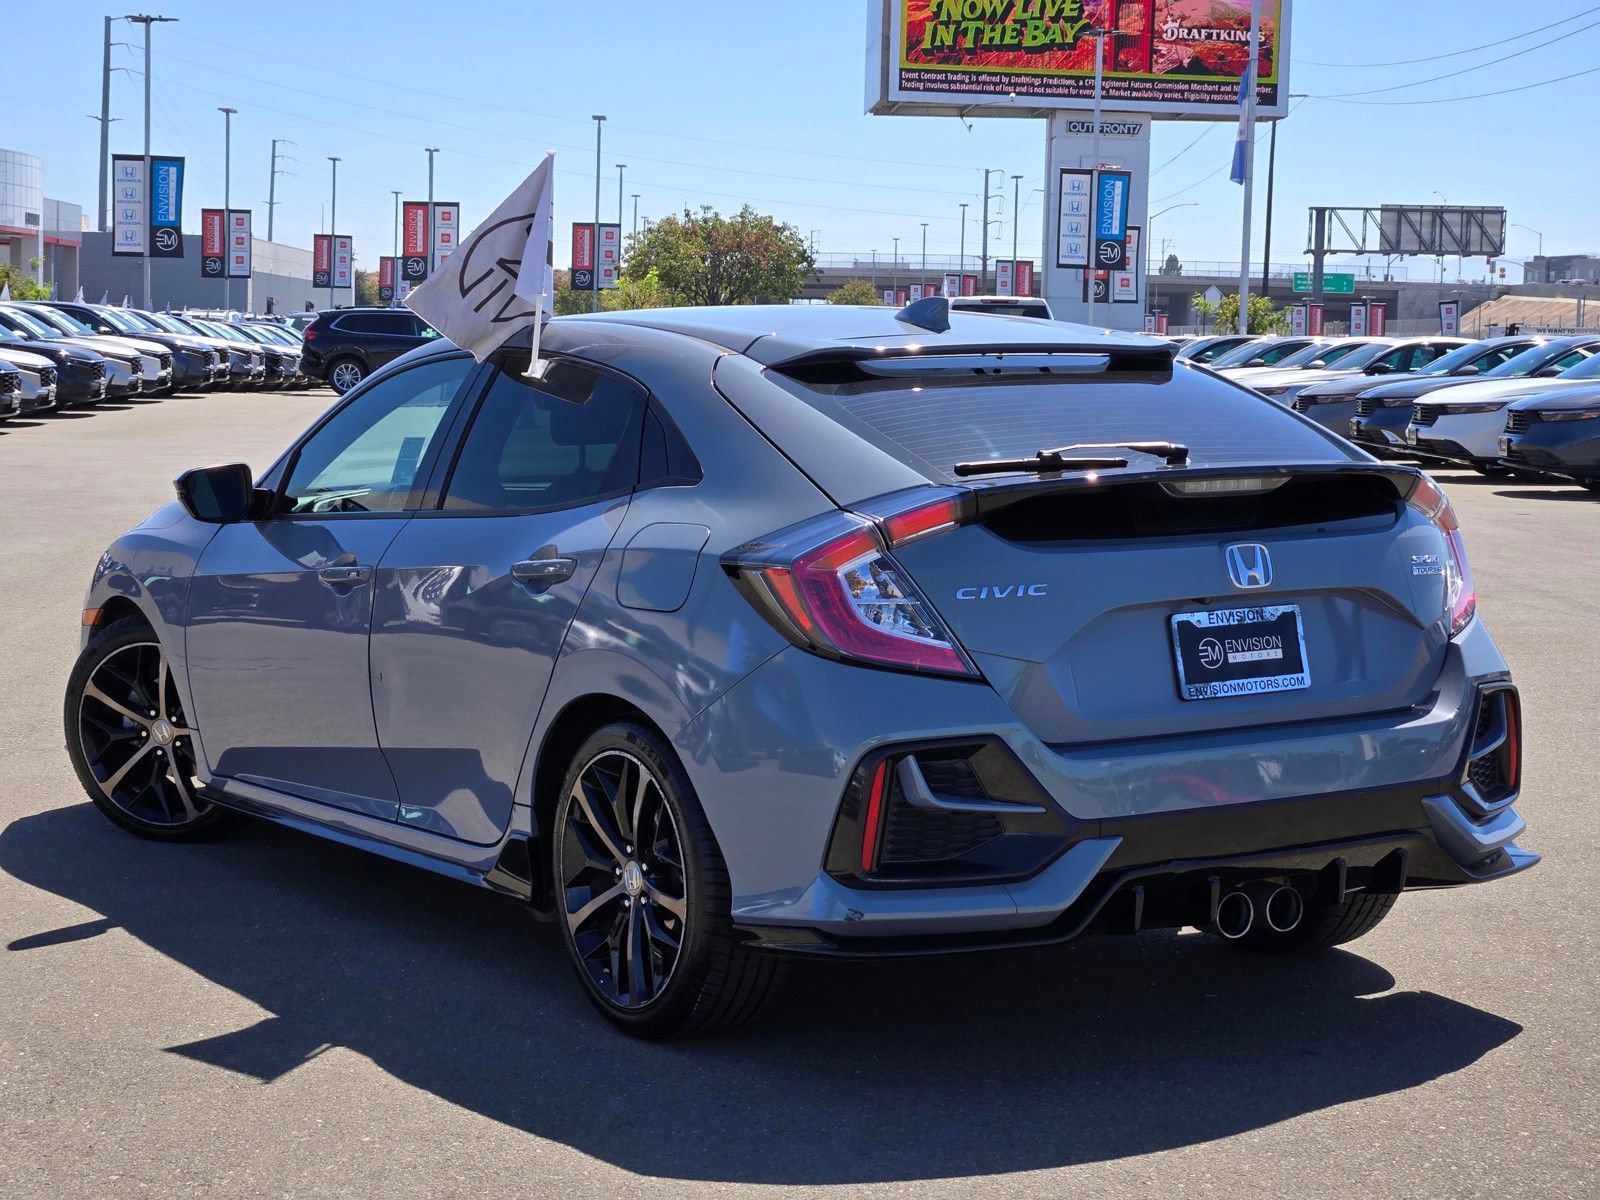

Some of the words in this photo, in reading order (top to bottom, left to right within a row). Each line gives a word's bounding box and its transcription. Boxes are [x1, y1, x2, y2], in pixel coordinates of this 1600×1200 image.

[930, 0, 1009, 21] NOW
[1013, 0, 1082, 20] LIVE
[921, 21, 957, 49] IN
[961, 21, 1021, 49] THE
[1022, 18, 1091, 48] BAY
[902, 71, 919, 79] Event
[921, 72, 946, 80] Contract
[947, 73, 970, 83] Trading
[1001, 75, 1009, 84] by
[1011, 76, 1041, 85] DraftKings
[1043, 77, 1077, 86] Predictions,
[1130, 81, 1153, 89] Futures
[1154, 82, 1190, 90] Commission
[1191, 83, 1219, 91] Merchant
[1220, 84, 1232, 92] and
[902, 80, 924, 90] Trading
[925, 81, 950, 89] involves
[950, 82, 983, 90] substantial
[995, 84, 1002, 92] of
[1070, 87, 1079, 95] for
[1109, 89, 1131, 97] Market
[1131, 90, 1163, 100] availability
[1184, 92, 1211, 102] Eligibility
[1211, 93, 1237, 101] restrictio
[158, 165, 169, 221] ENVISION
[1102, 180, 1115, 235] ENVISION
[206, 215, 215, 253] ENVISION
[408, 208, 417, 253] ENVISION
[956, 584, 1048, 600] CIVIC
[1207, 608, 1264, 625] ENVISION
[1225, 635, 1282, 653] ENVISION
[1231, 650, 1279, 661] MOTORS
[1188, 676, 1306, 697] ENVISIONMOTORS.COM
